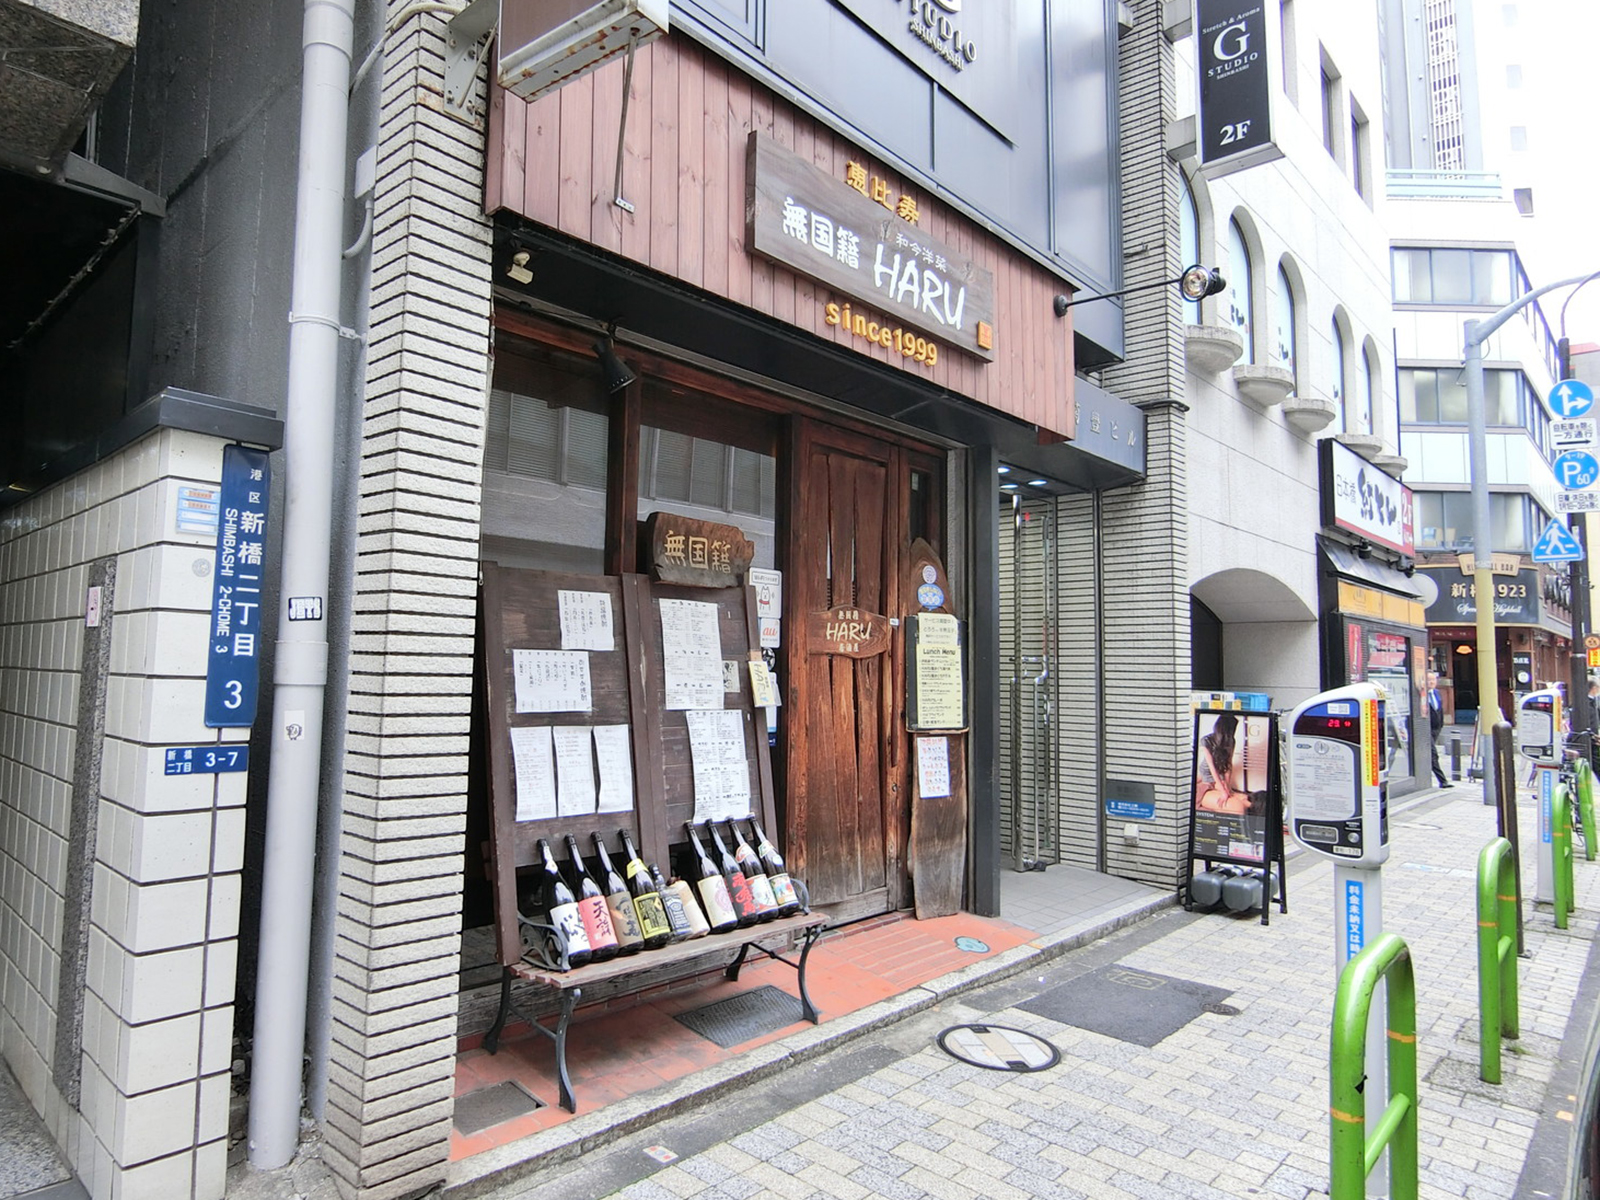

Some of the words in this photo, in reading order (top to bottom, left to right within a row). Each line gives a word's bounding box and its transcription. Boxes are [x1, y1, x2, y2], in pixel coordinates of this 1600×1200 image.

[1202, 19, 1228, 35] Stretch
[1228, 16, 1235, 24] &
[1236, 7, 1260, 21] Aroma
[908, 18, 964, 72] SHINBASHI
[1213, 21, 1251, 60] G
[1207, 52, 1259, 77] STUDIO
[1220, 120, 1251, 146] 2F
[846, 160, 920, 226] 恵比寿
[782, 196, 860, 270] 無国籍
[873, 243, 966, 331] HARU
[825, 303, 938, 367] since1999
[1554, 431, 1593, 439] 一方通行
[248, 468, 263, 504] 港区
[1563, 461, 1581, 486] P
[1576, 473, 1591, 485] 60
[220, 508, 238, 577] SHIMBASHI
[664, 529, 732, 574] 無国籍
[233, 510, 265, 657] 新橋二丁目
[216, 585, 232, 637] 2-CHOME
[763, 627, 777, 636] au
[826, 622, 871, 642] HARU
[215, 644, 228, 653] 3
[223, 680, 243, 709] 3
[166, 762, 192, 774] 二丁目
[205, 752, 239, 768] 3-7
